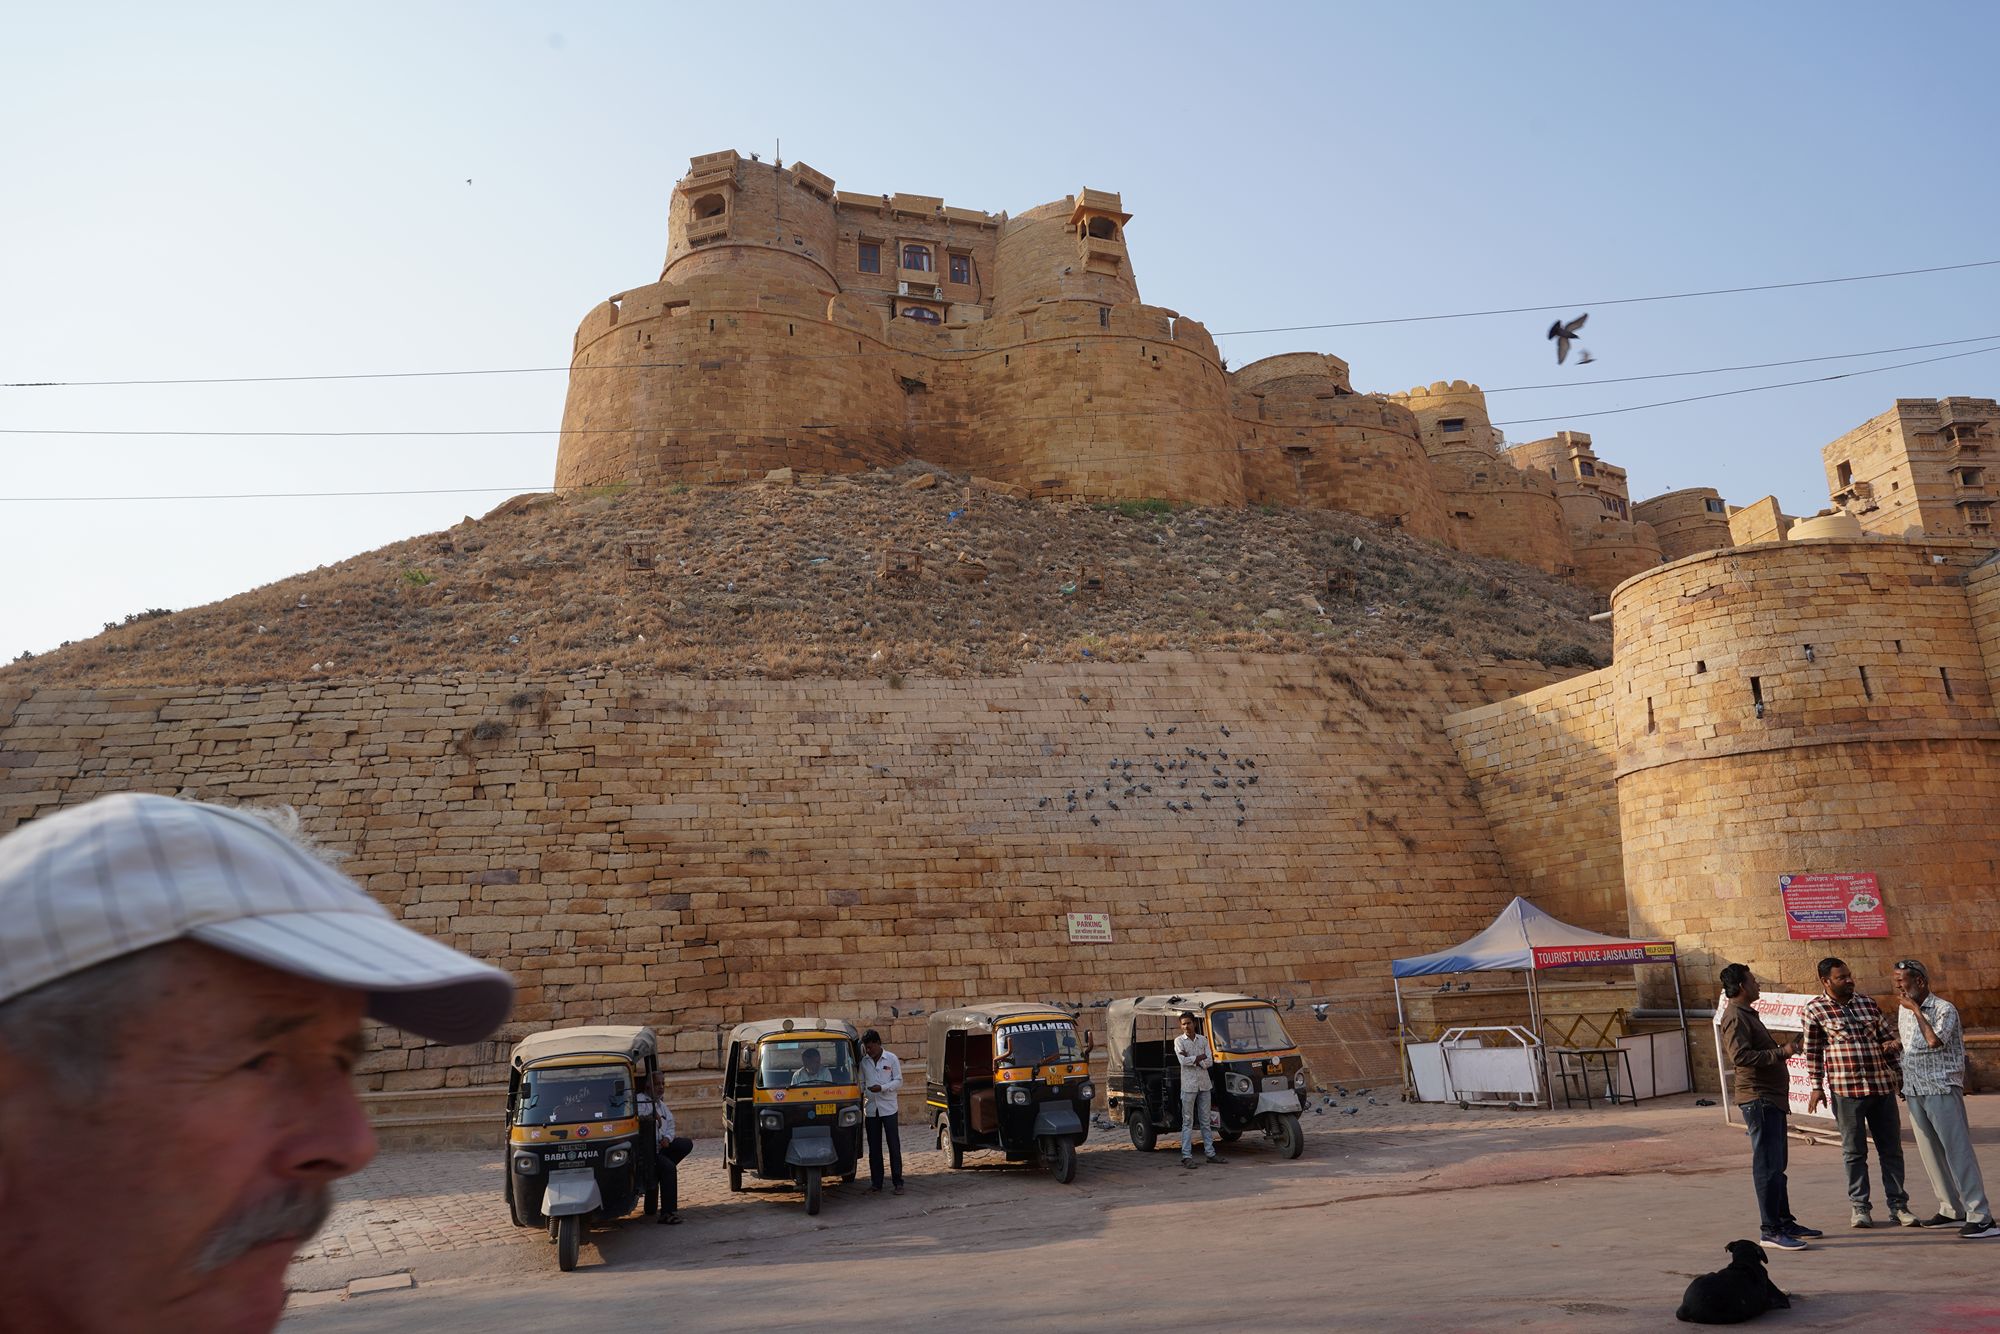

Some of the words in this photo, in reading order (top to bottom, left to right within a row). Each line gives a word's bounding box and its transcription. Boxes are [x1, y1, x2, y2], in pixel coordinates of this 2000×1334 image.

[1537, 951, 1573, 964] TOURIST
[1573, 950, 1600, 962] POLICE
[1602, 948, 1644, 961] JAISALMER
[544, 1153, 567, 1161] BABA
[577, 1150, 599, 1159] AQUA
